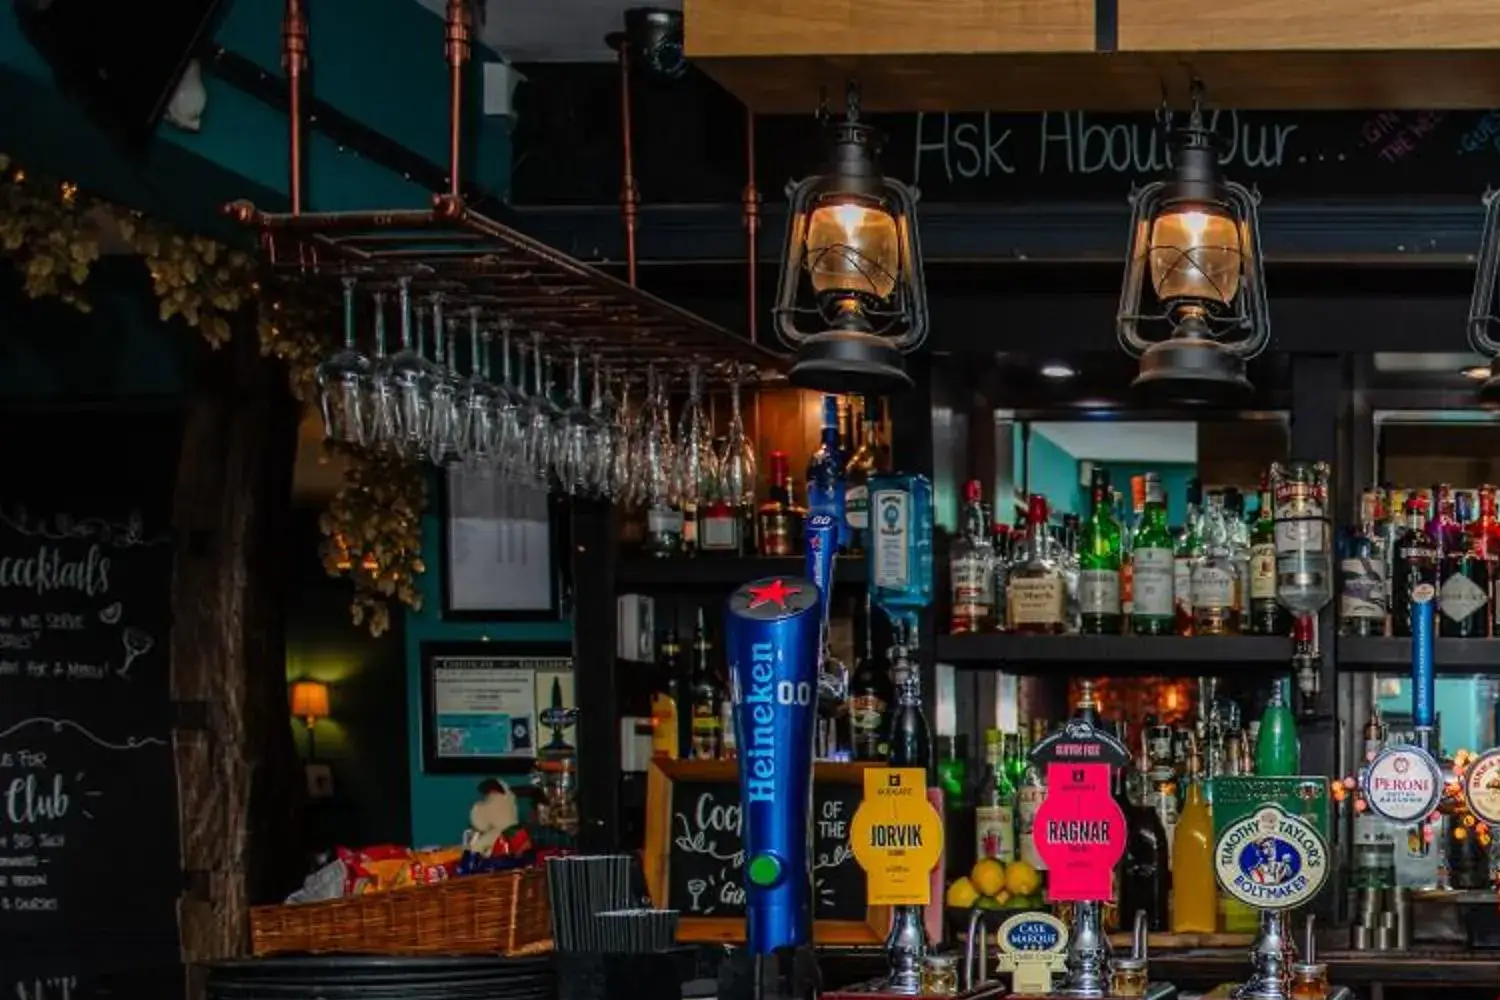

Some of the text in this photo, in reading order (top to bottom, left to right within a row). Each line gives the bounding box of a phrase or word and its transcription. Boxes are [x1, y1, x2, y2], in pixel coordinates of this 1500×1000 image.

[1039, 110, 1173, 175] Abou
[748, 642, 775, 802] Heineken
[1375, 777, 1429, 791] PERONI
[823, 801, 844, 818] OF
[817, 821, 847, 840] THE
[871, 824, 923, 847] JORVIK
[1047, 820, 1110, 845] RAGNAR
[1222, 820, 1261, 866] TIMOTHY
[1233, 875, 1306, 898] BOLTMAKER
